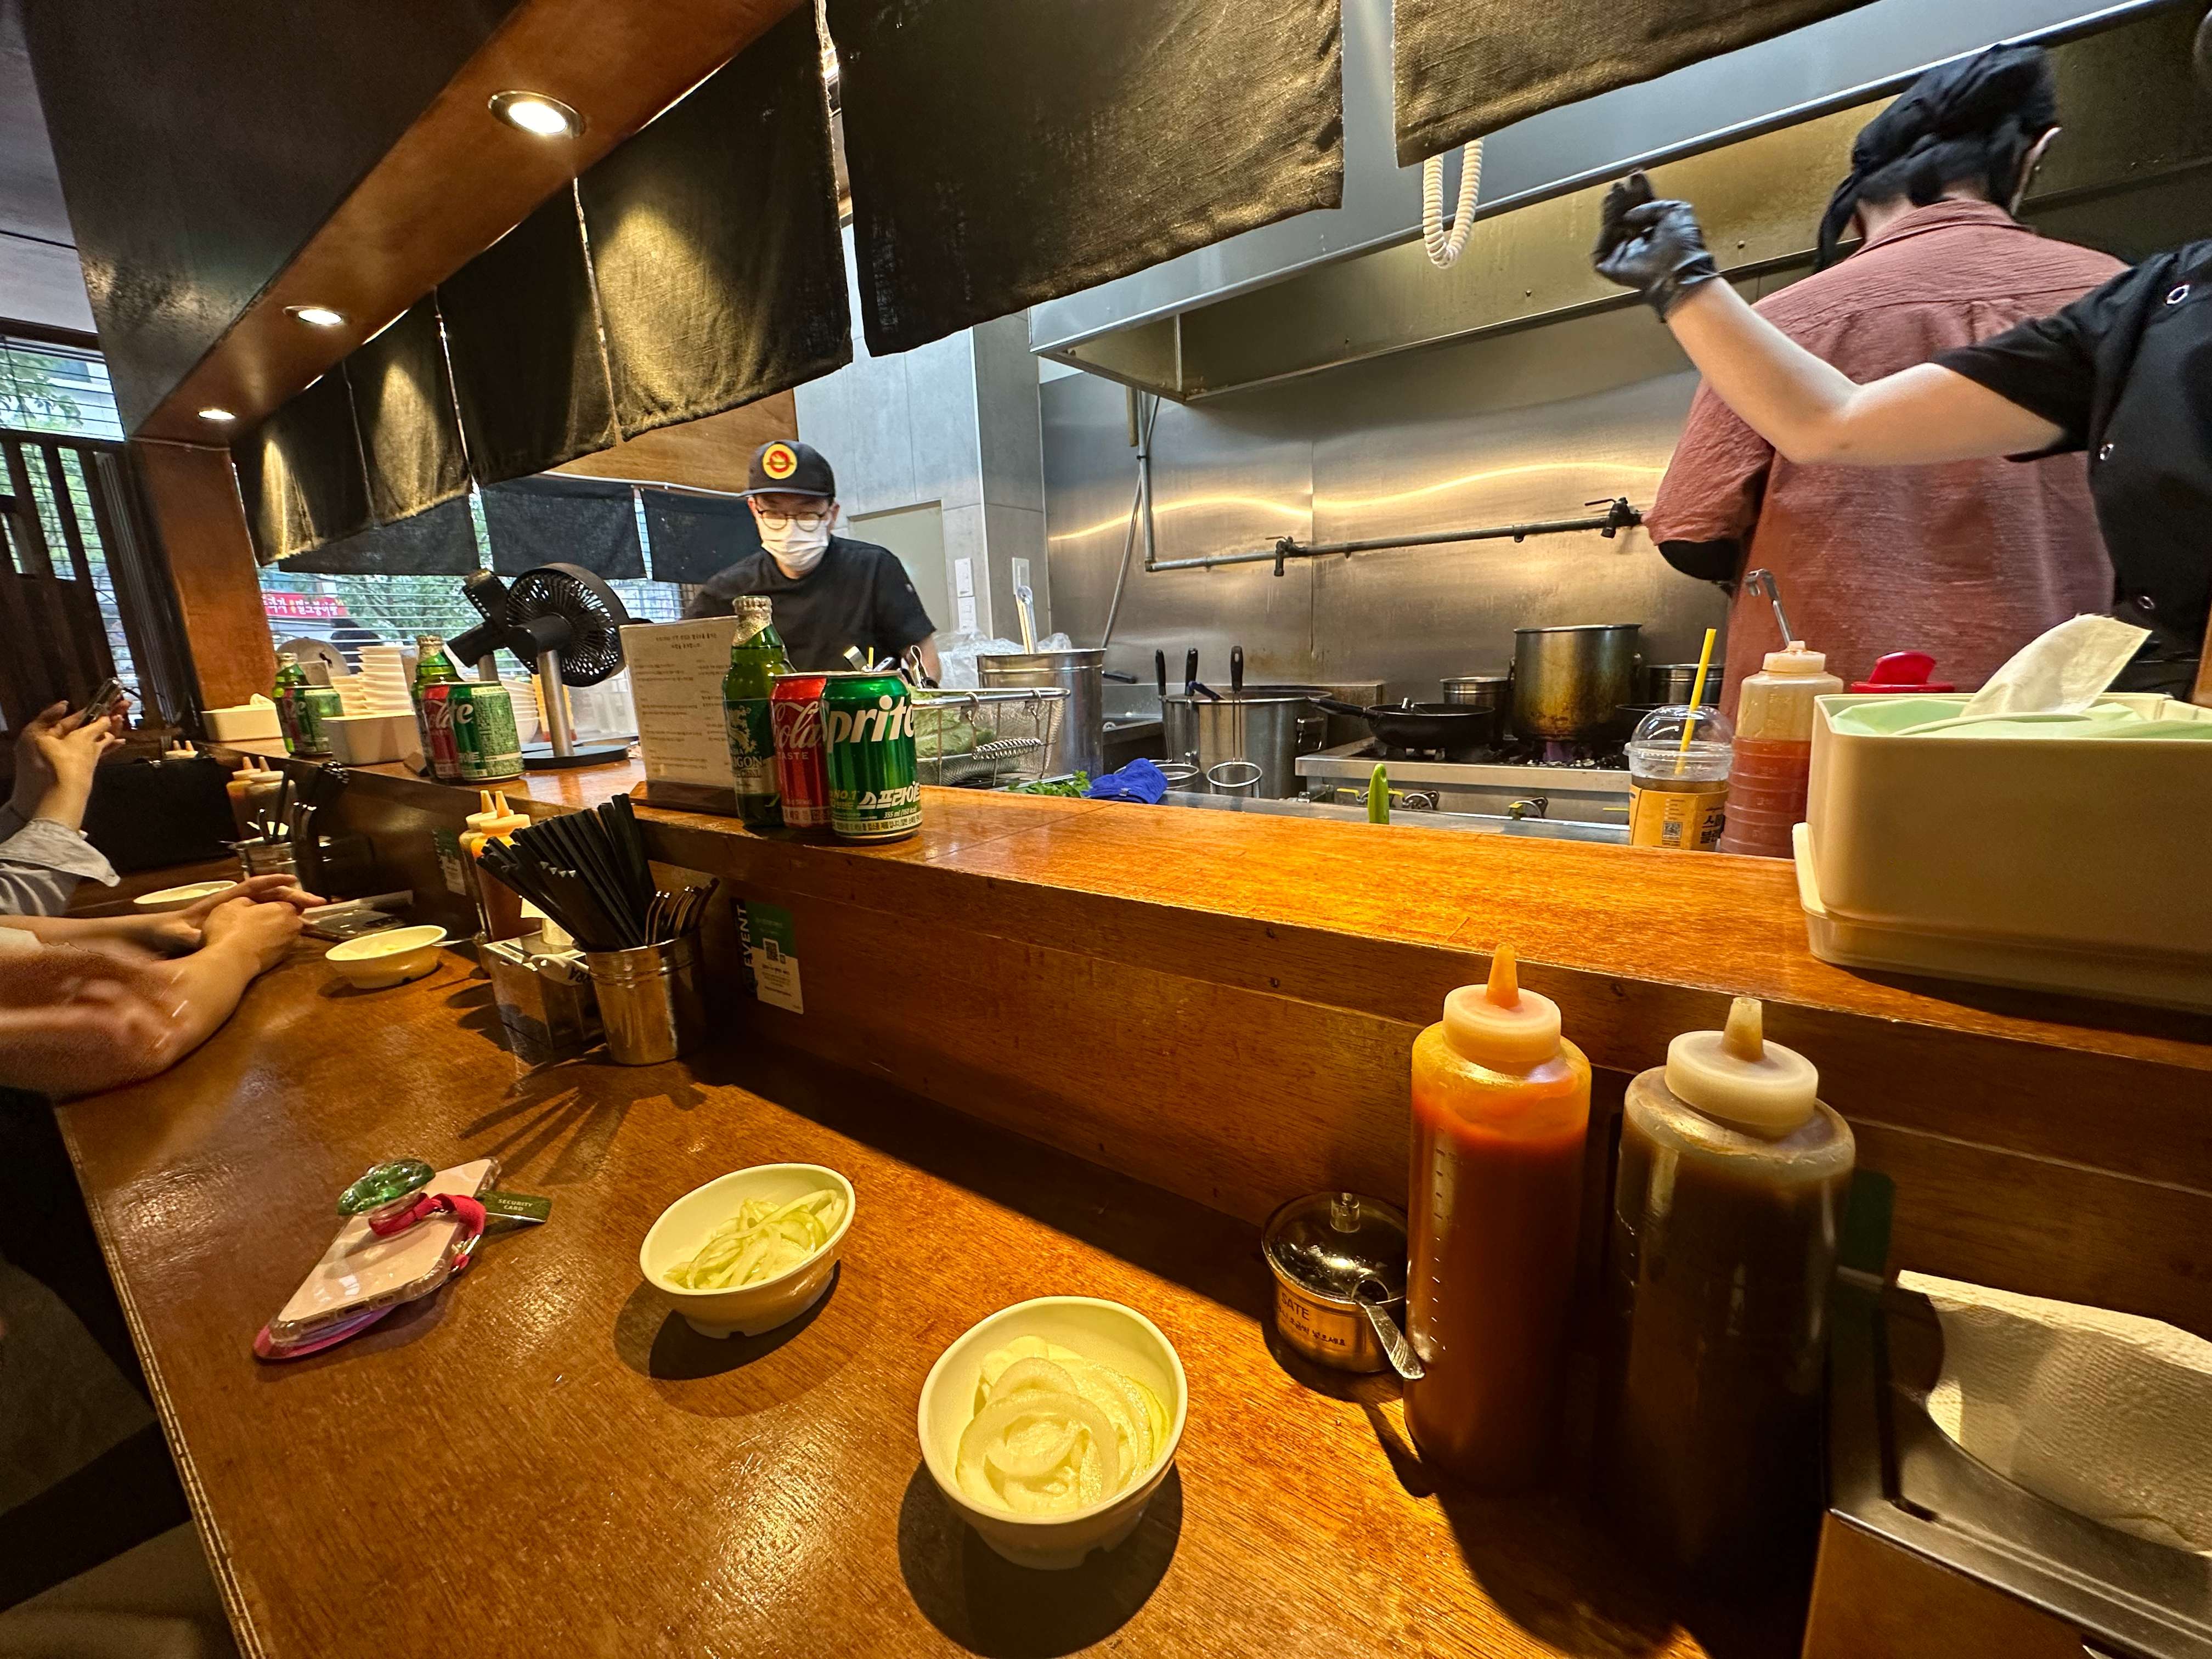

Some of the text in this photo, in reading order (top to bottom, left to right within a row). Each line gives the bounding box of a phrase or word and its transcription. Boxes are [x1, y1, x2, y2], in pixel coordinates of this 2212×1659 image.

[737, 904, 754, 967] EVENT
[498, 1199, 533, 1207] SECURITY
[1281, 1292, 1310, 1321] SATE
